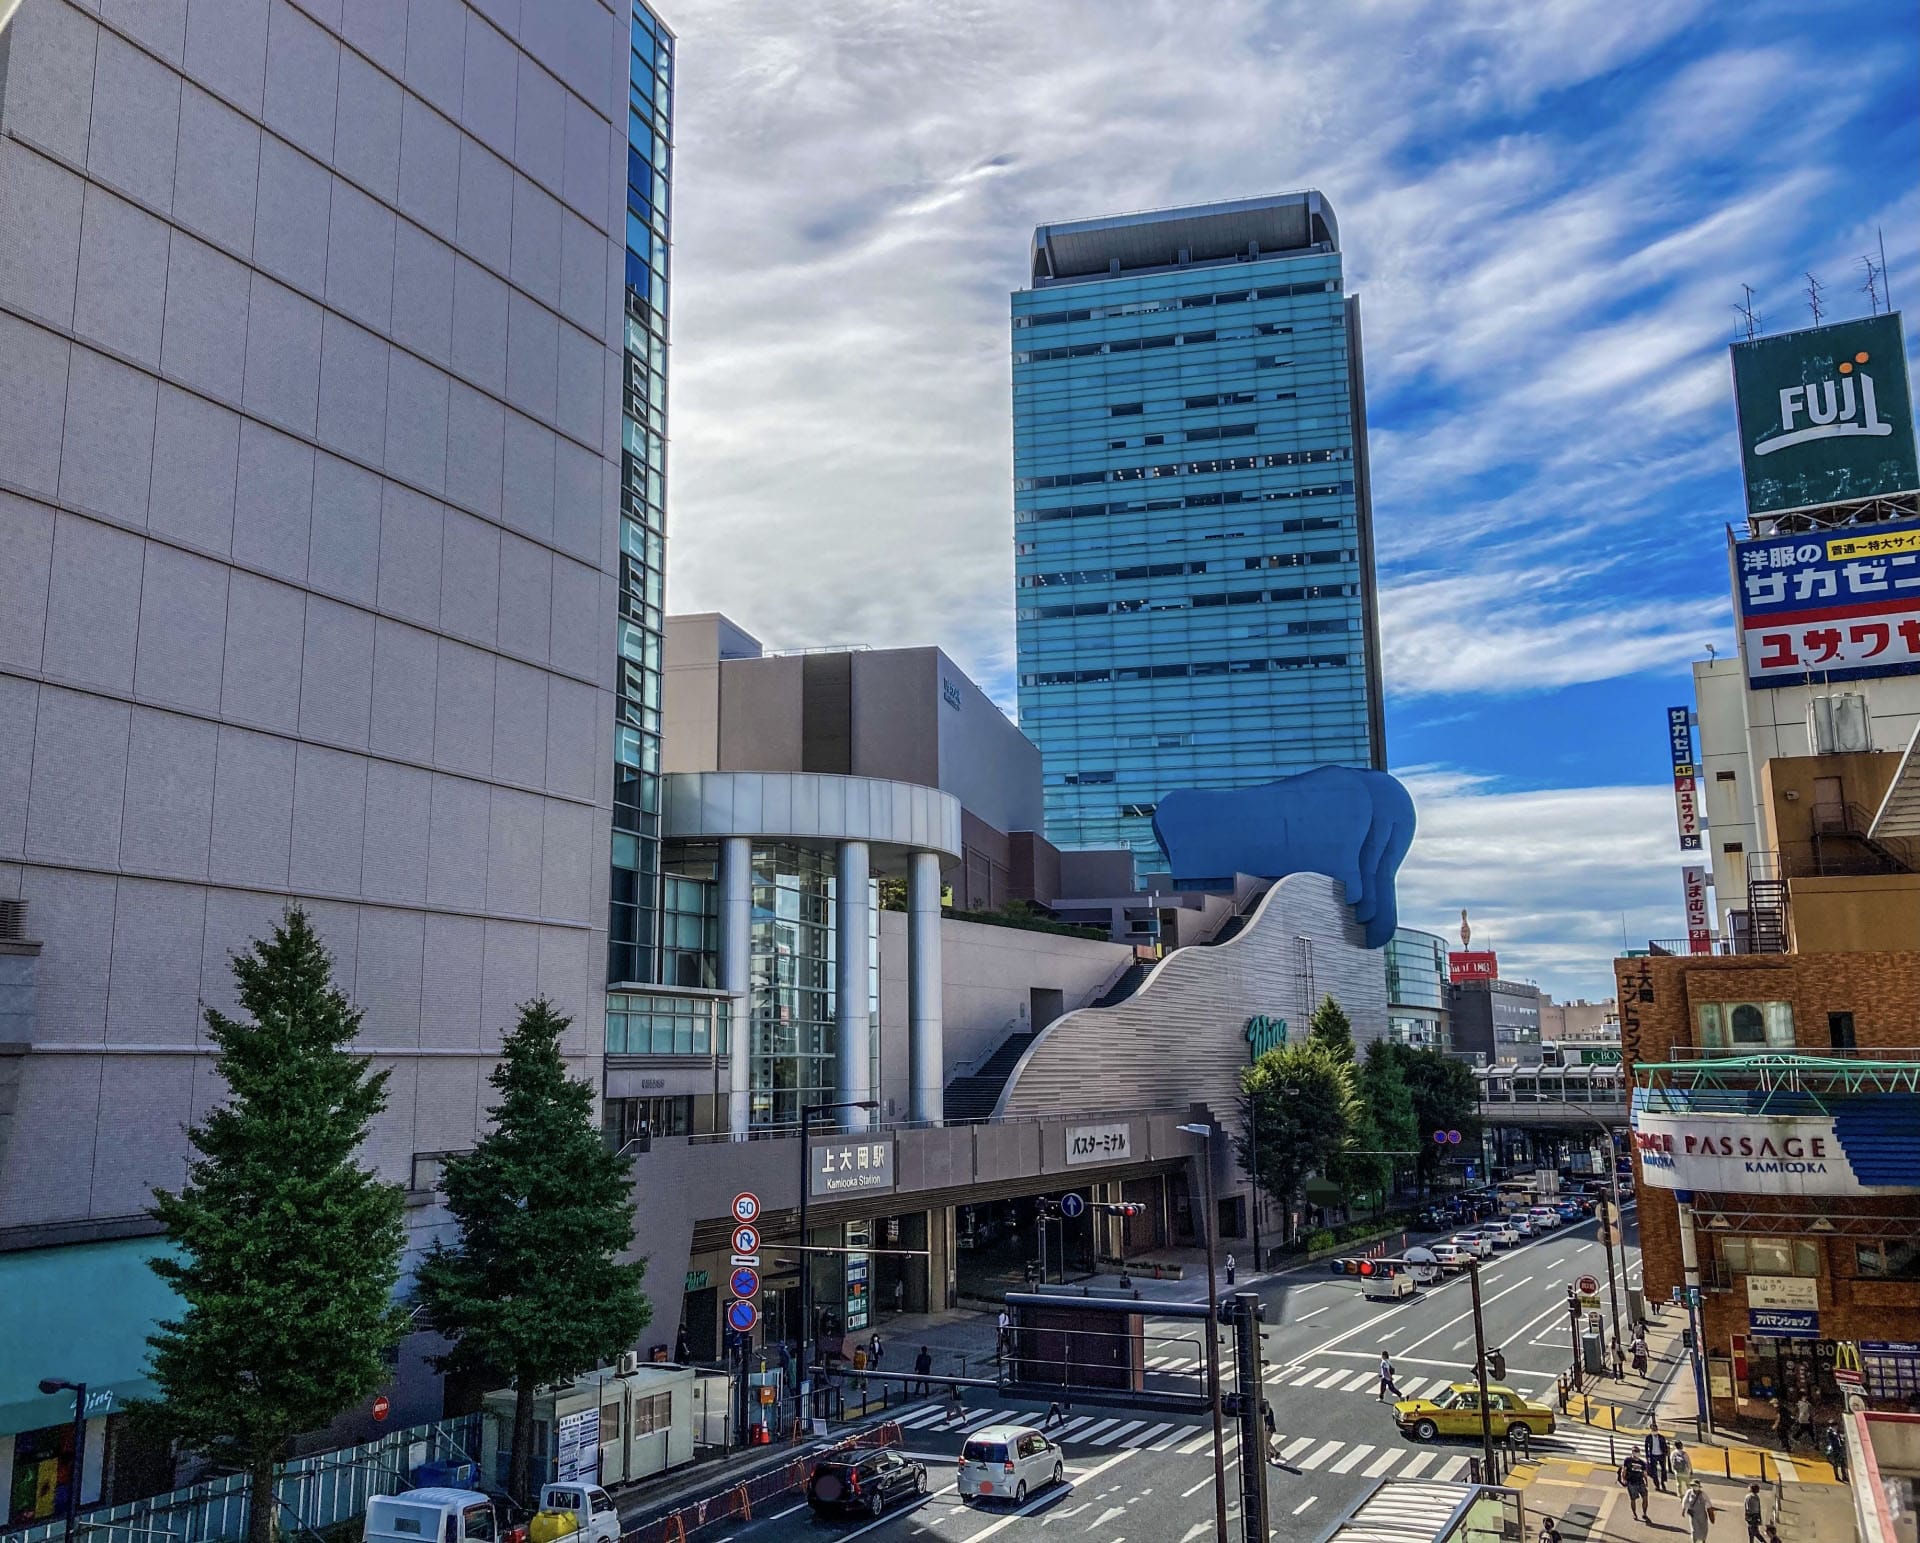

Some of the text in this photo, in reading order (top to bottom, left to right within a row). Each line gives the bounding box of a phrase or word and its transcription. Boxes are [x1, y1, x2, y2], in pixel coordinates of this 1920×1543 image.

[1831, 534, 1920, 556] 普通～特大サイ
[1742, 544, 1822, 571] 洋服の
[1671, 710, 1690, 764] サカゼン
[1675, 766, 1692, 775] 4F
[1684, 838, 1697, 847] 3F
[1687, 871, 1704, 925] しまむら
[1692, 930, 1706, 938] 2F
[1072, 1133, 1126, 1155] バスターミナル
[1684, 1135, 1826, 1158] PASSAGE
[821, 1144, 885, 1173] 上大岡駅
[1745, 1161, 1827, 1174] KAMIOOKA
[827, 1174, 881, 1191] Kamiooka Station
[738, 1201, 754, 1215] 50
